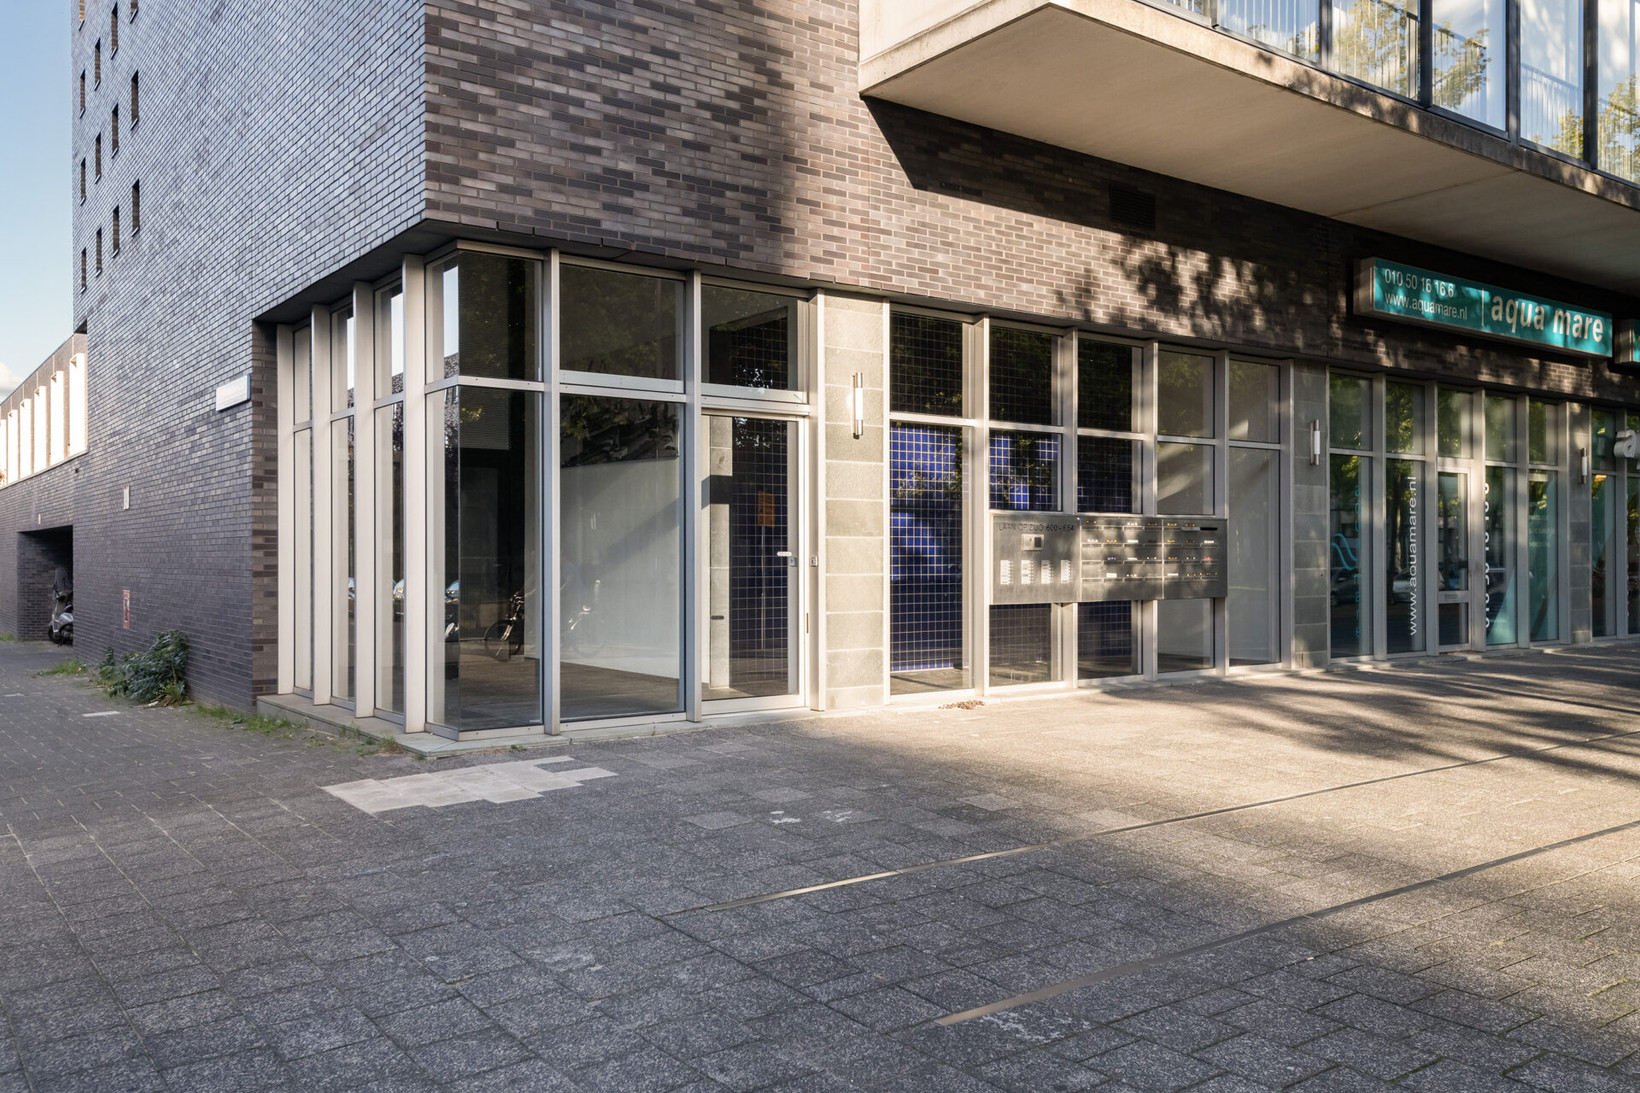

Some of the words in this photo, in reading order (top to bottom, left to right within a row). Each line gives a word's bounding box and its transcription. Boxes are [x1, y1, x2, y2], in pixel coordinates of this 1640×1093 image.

[1385, 268, 1403, 287] 010
[1405, 273, 1418, 290] 50
[1421, 277, 1432, 293] 16
[1385, 292, 1468, 320] www.aquamare.nl
[1491, 296, 1545, 333] aqua
[1553, 309, 1604, 342] mare
